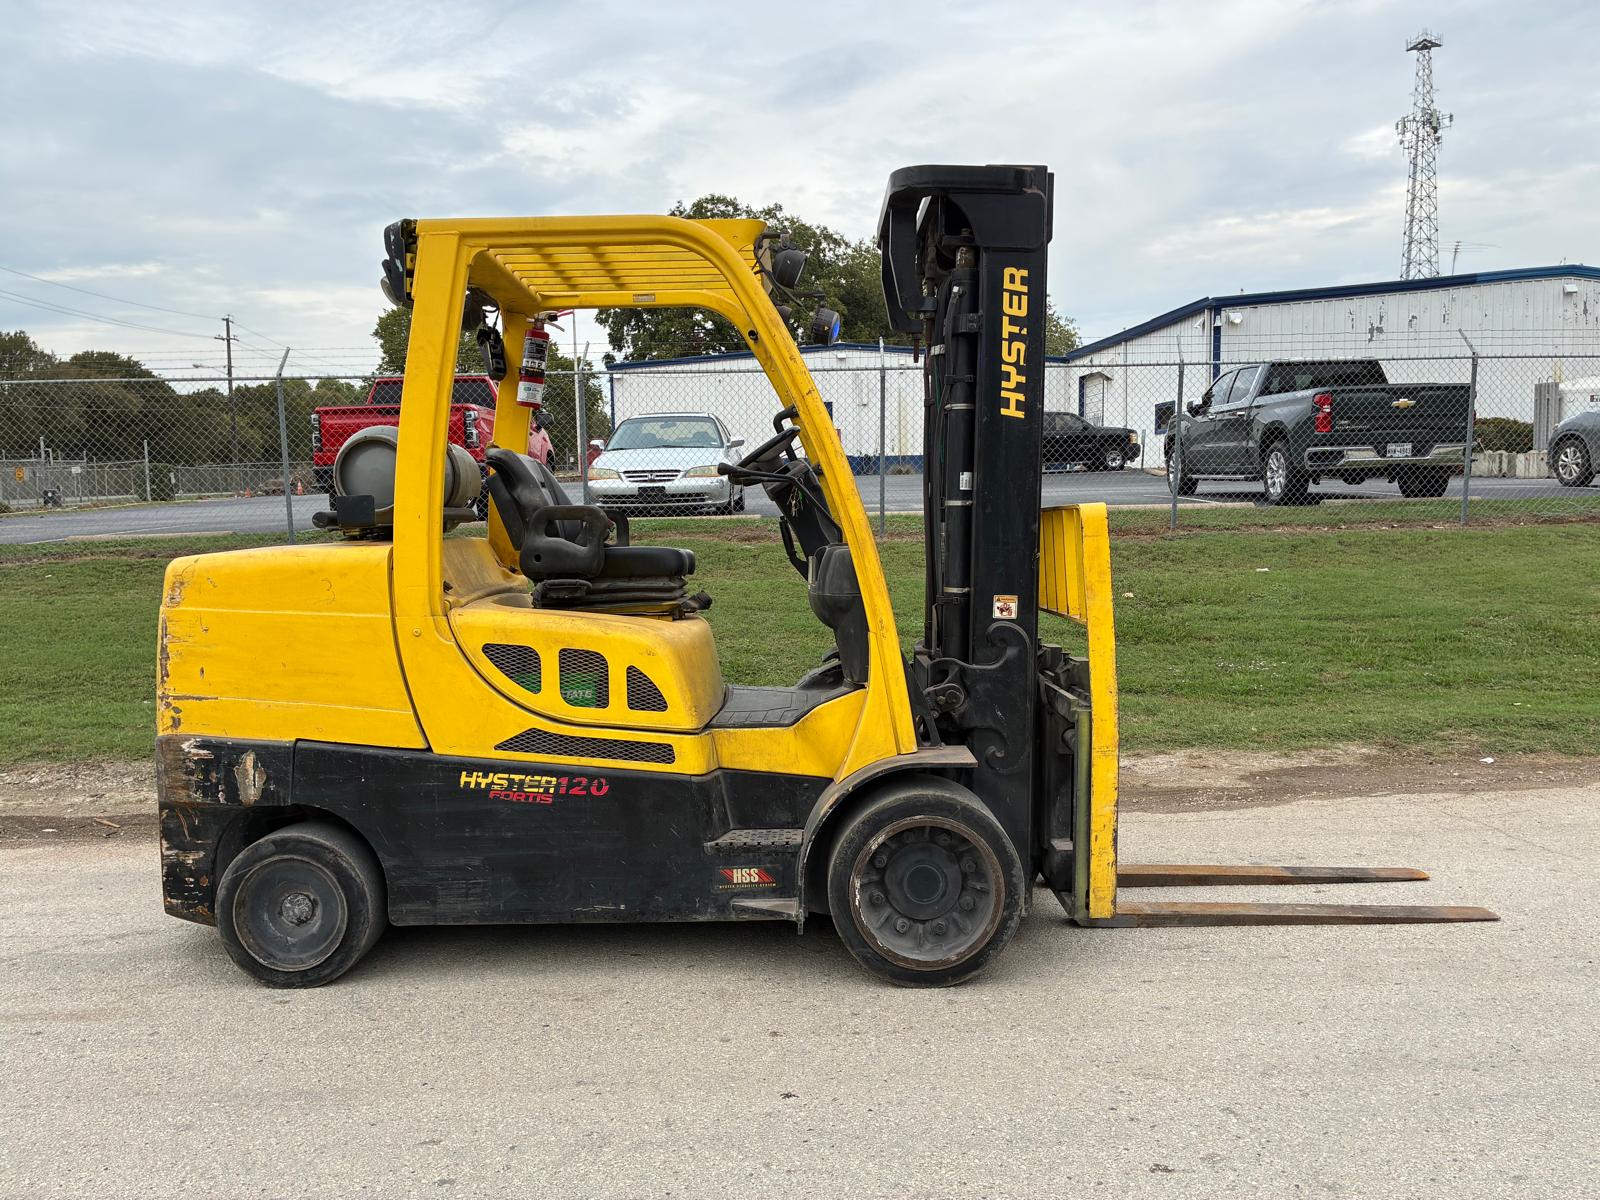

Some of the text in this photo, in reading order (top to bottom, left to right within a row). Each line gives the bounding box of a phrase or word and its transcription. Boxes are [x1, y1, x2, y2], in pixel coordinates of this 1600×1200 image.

[1000, 266, 1029, 419] HYSTER
[459, 771, 609, 796] HYSTER 120
[489, 790, 554, 804] FORTIS
[733, 868, 759, 883] HSS
